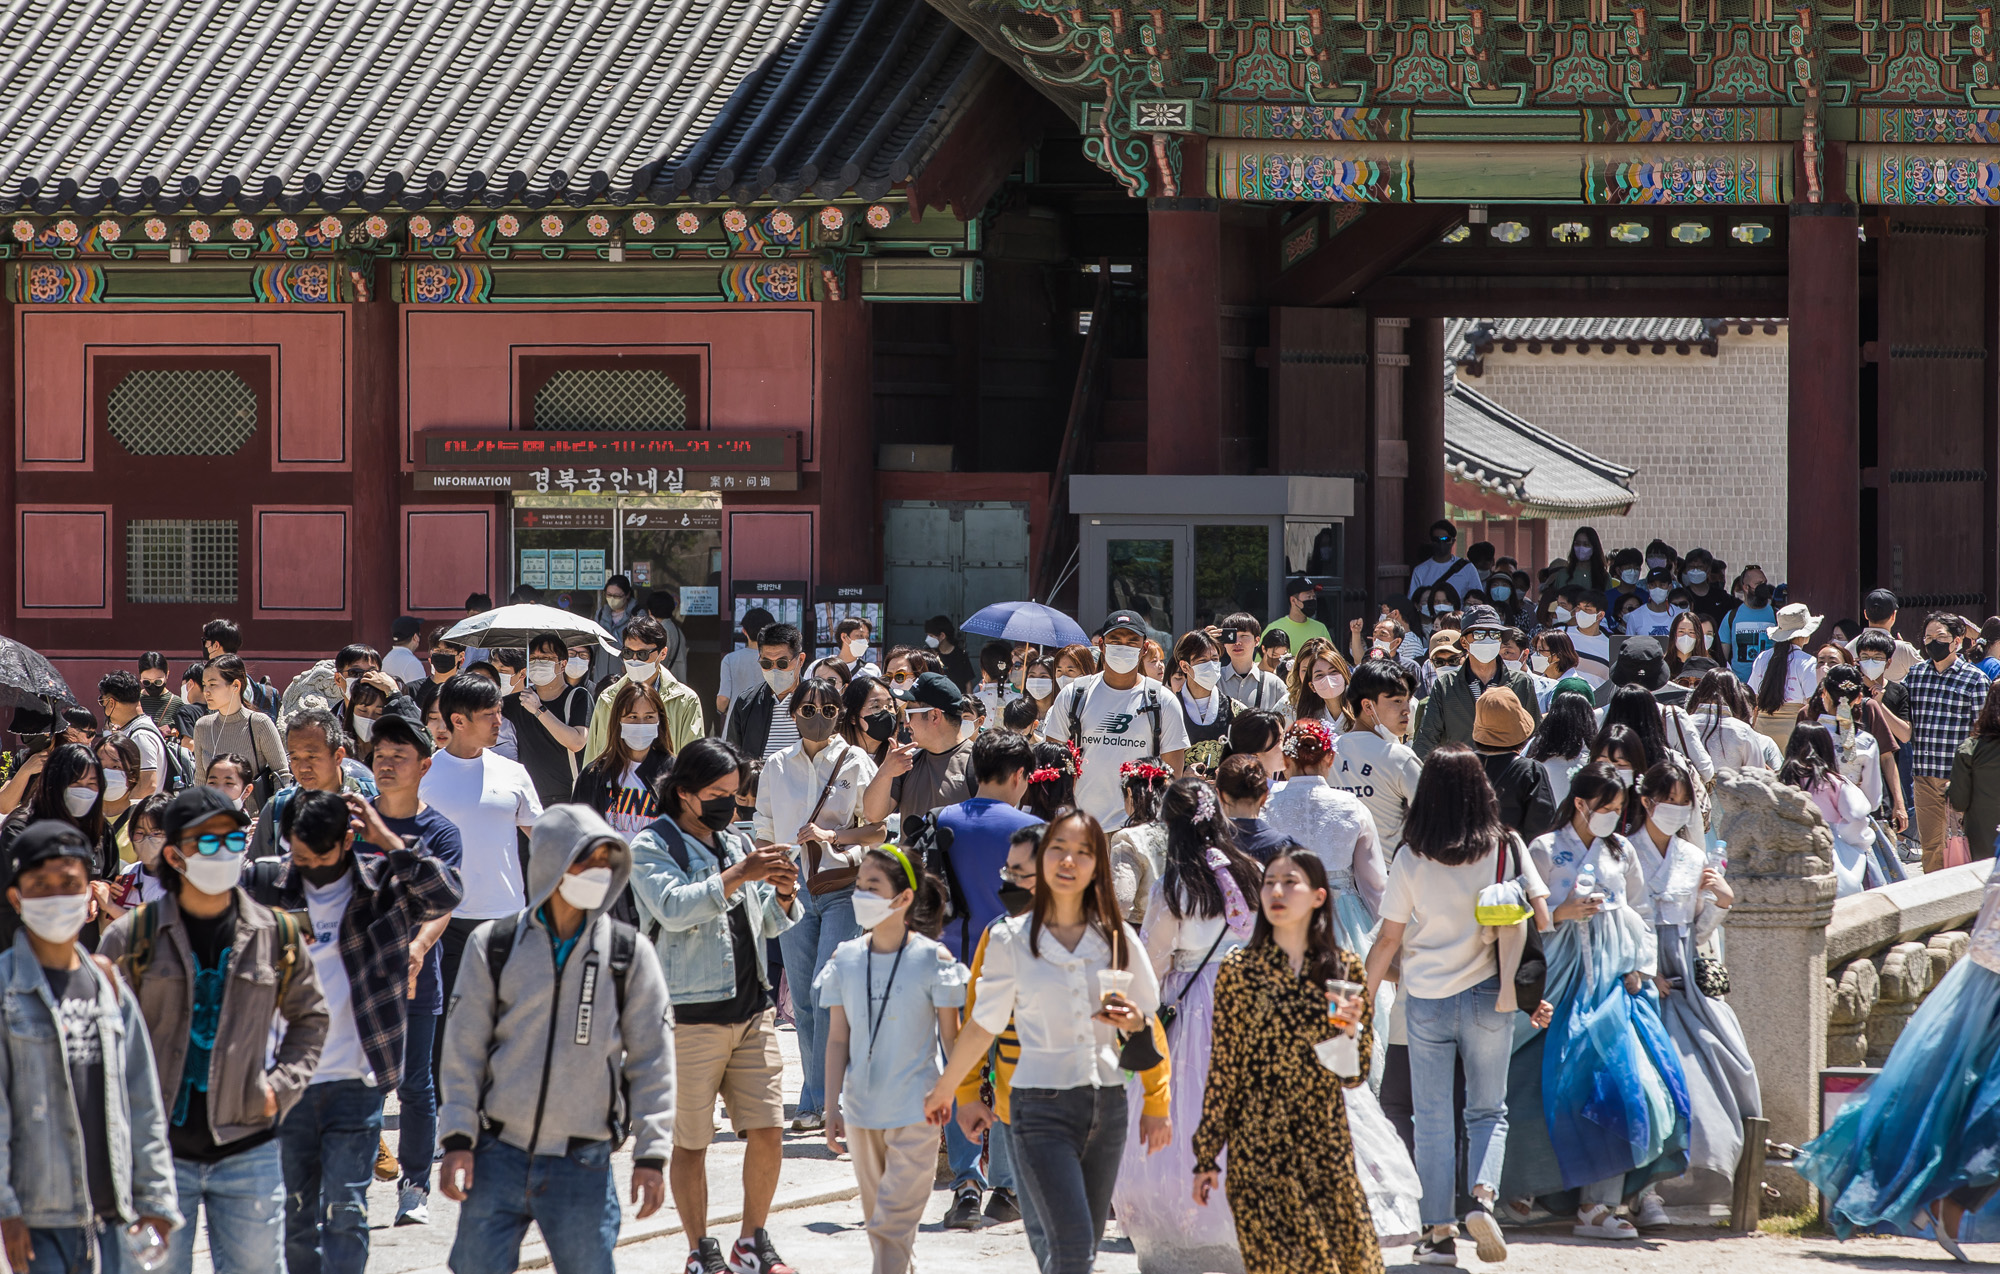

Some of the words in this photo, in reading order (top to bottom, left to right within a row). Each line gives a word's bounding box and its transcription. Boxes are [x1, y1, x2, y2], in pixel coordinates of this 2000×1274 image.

[433, 476, 512, 486] INFORMATION
[529, 467, 685, 494] 경복궁안내실
[756, 583, 782, 591] 관람안내
[837, 588, 863, 596] 관람안내
[1082, 736, 1102, 744] new
[1102, 735, 1147, 748] balance
